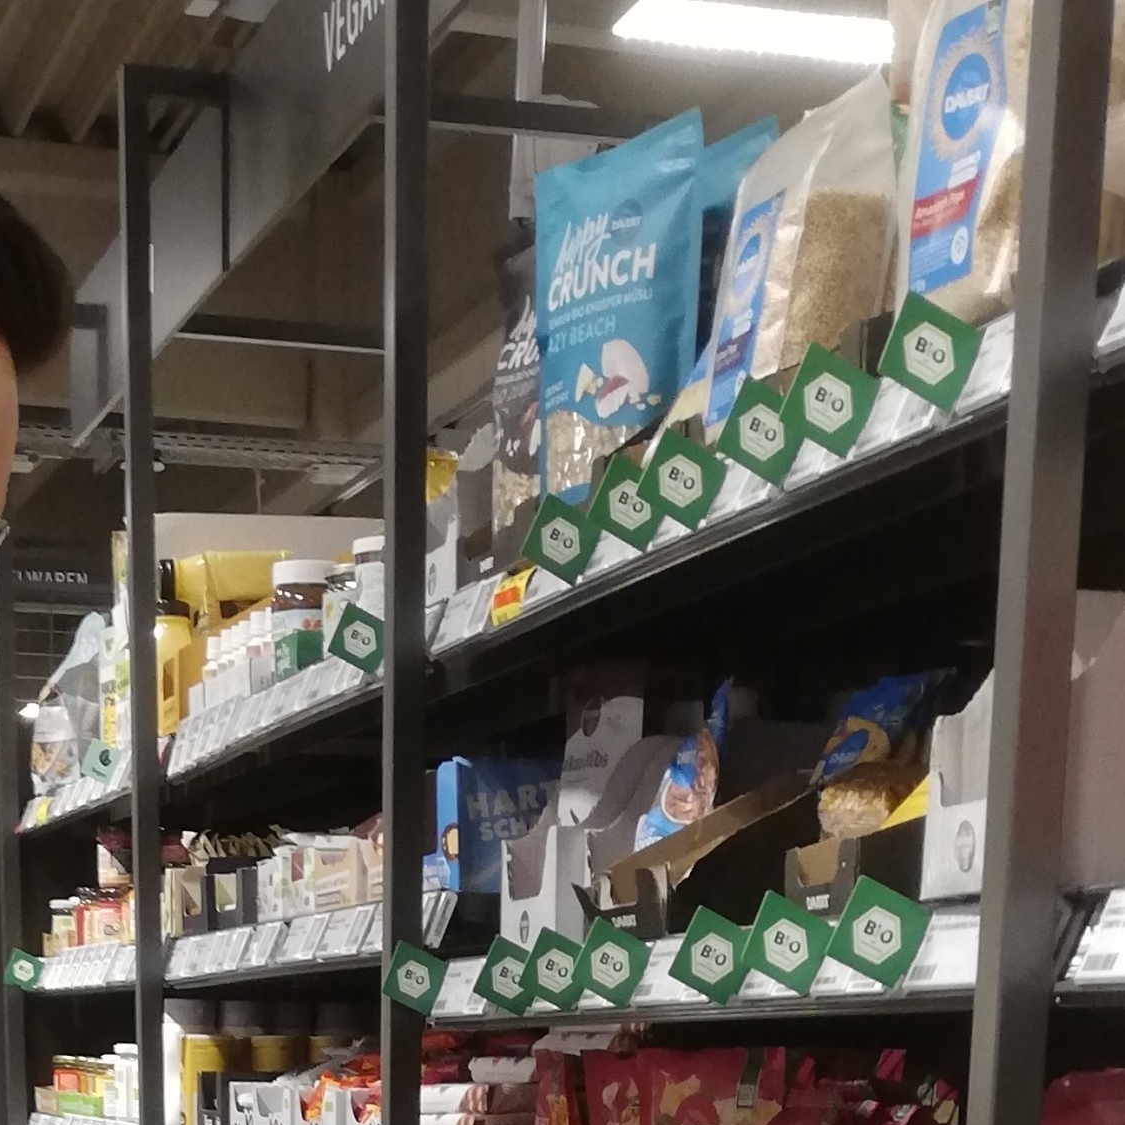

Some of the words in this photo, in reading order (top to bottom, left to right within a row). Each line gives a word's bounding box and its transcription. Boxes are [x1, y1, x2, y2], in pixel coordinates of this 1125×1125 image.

[322, 0, 385, 73] VEGA
[944, 83, 990, 114] DAVERT
[548, 243, 656, 312] CRUNCH
[569, 315, 617, 347] BEACH
[497, 338, 540, 370] CRU
[479, 816, 529, 842] SCH
